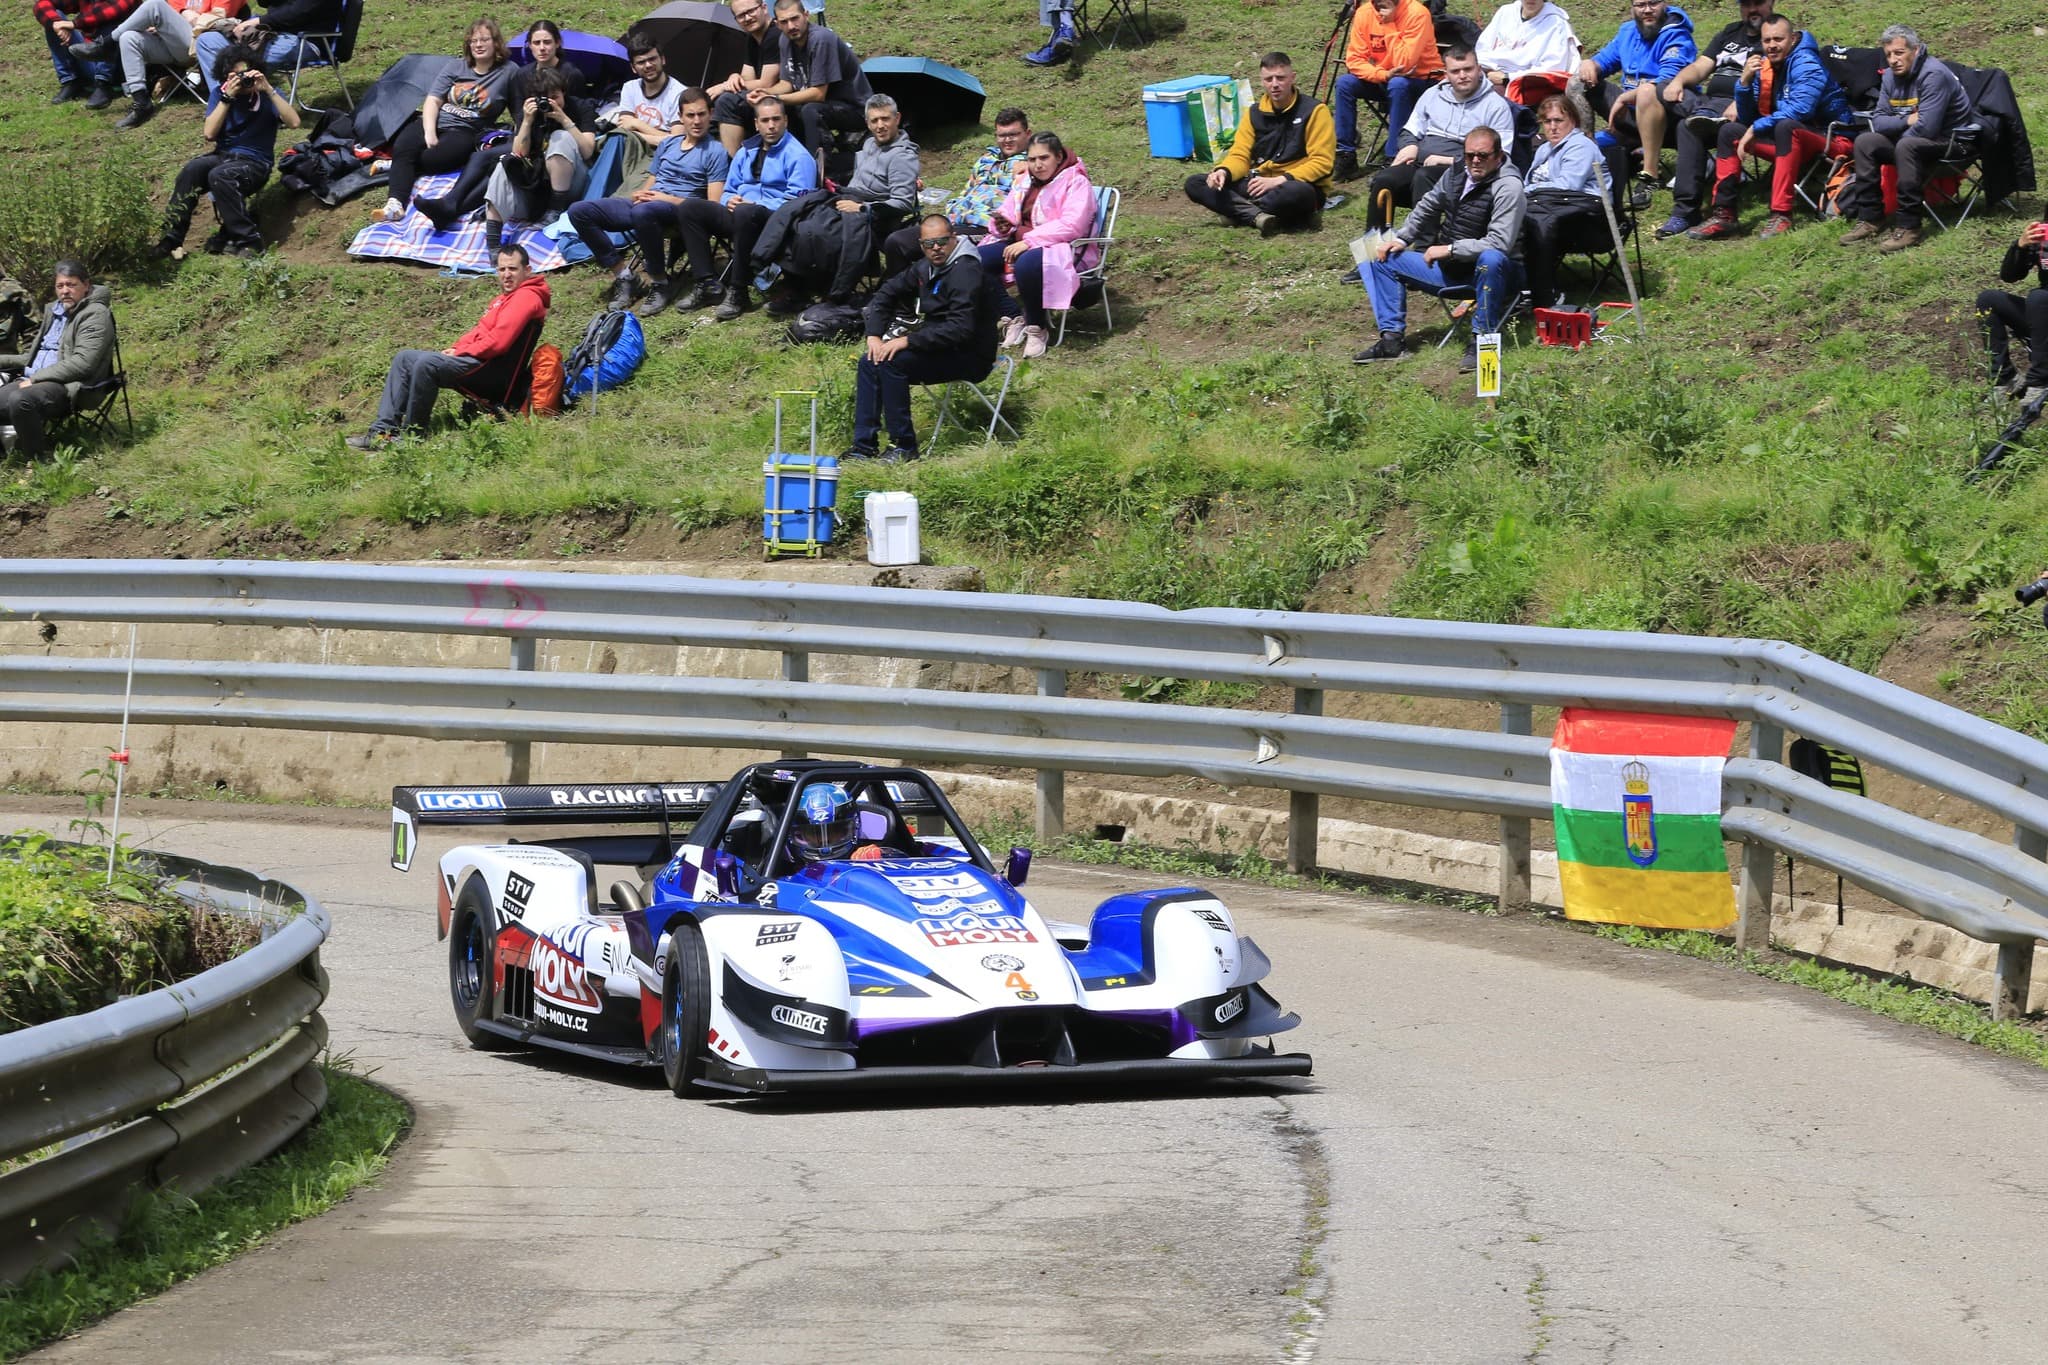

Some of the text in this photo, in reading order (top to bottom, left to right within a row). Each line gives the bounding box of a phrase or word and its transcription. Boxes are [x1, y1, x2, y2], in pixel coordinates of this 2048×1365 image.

[423, 795, 498, 809] LIQUI
[396, 823, 405, 864] 4
[507, 876, 532, 899] STV
[898, 878, 959, 887] STV
[762, 923, 797, 935] STV
[922, 913, 1024, 933] LIQUI
[759, 934, 794, 945] GROUP
[933, 928, 1034, 946] MOLY
[529, 940, 588, 1002] MOLY
[1005, 971, 1033, 991] 4
